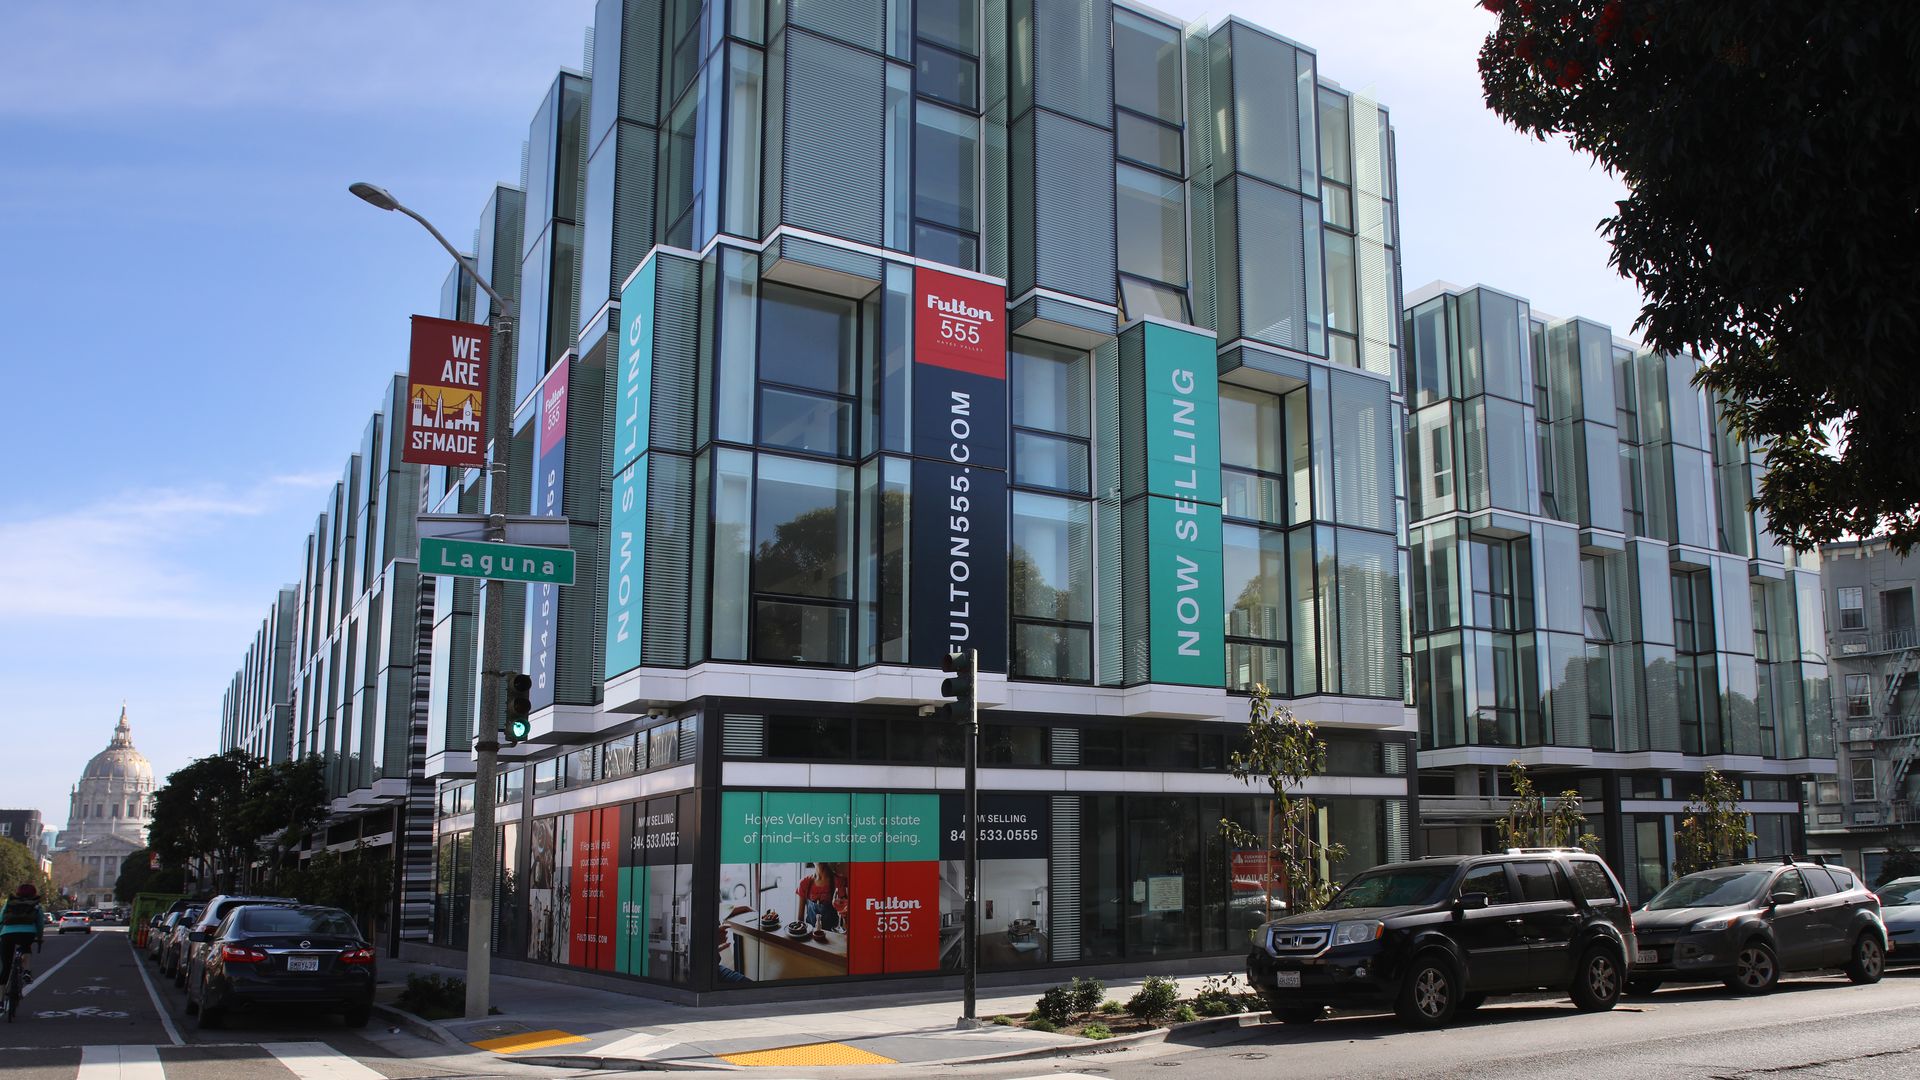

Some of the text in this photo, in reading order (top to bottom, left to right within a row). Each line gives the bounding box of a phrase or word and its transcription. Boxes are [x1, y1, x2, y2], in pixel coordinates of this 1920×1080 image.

[927, 294, 994, 322] Fulton
[940, 319, 980, 344] 555
[452, 335, 481, 362] WE
[441, 360, 480, 386] ARE
[548, 405, 560, 431] 555
[412, 431, 478, 454] SFMADE
[617, 313, 642, 643] NOW SELLING
[1171, 368, 1200, 656] NOW SELLING
[441, 547, 554, 575] Laguna
[651, 812, 674, 826] SELLING
[745, 813, 920, 828] Hayes Valley isn't just a state
[987, 814, 1027, 823] SELLING
[744, 832, 758, 844] of
[823, 834, 831, 844] a
[834, 832, 867, 844] state
[870, 832, 882, 843] of
[885, 831, 921, 846] being.
[950, 829, 1038, 841] 84.533.0555
[865, 896, 922, 910] Fulton
[877, 916, 910, 932] 555
